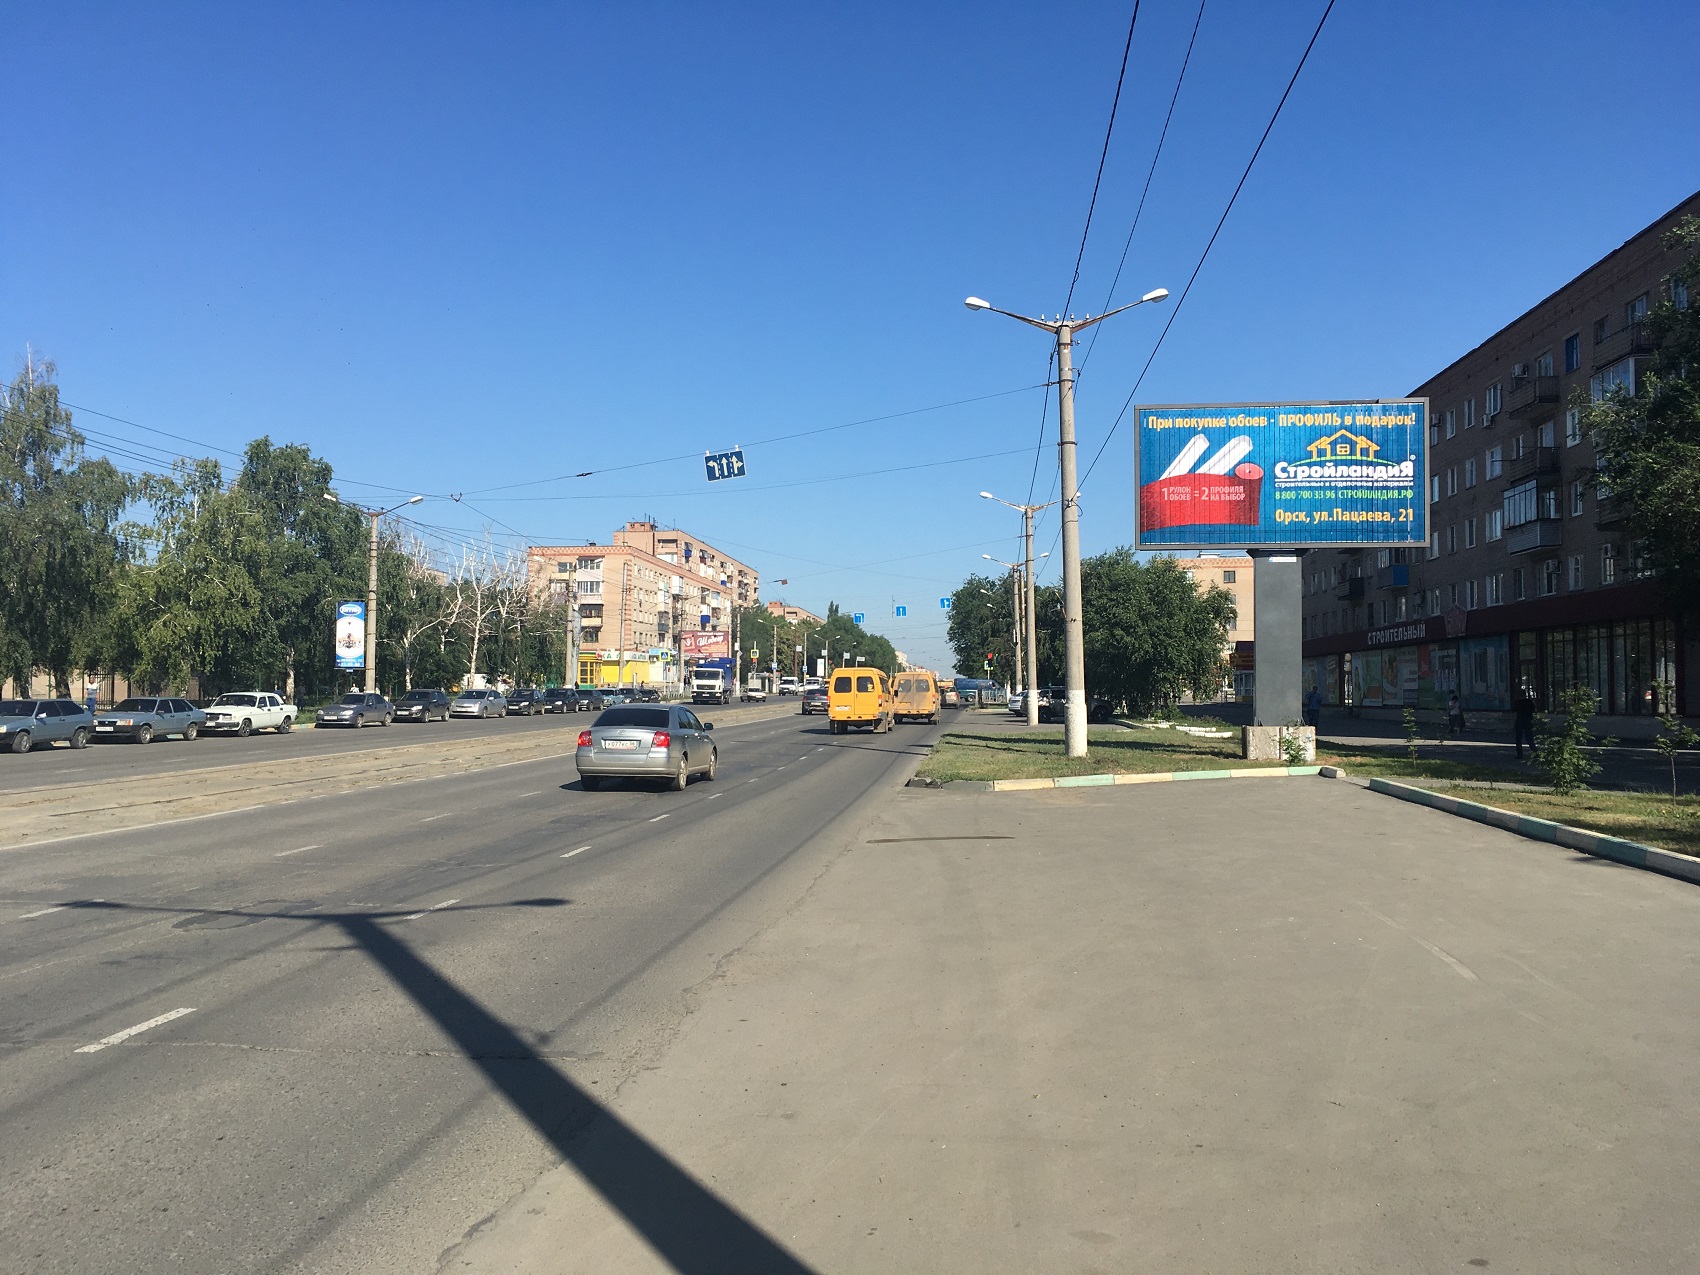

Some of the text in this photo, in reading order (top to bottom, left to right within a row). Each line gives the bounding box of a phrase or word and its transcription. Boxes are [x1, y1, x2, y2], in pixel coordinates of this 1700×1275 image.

[1148, 415, 1173, 431] При
[1175, 416, 1227, 431] покупке
[1229, 414, 1268, 427] обоев
[1278, 413, 1342, 427] ПРОФИЛЬ
[1344, 415, 1353, 426] в
[1355, 412, 1416, 428] подарок!
[1373, 480, 1414, 488] материалы
[1161, 486, 1192, 500] 1 РУЛОН
[1169, 493, 1192, 501] ОБОЕВ
[1201, 485, 1244, 500] 2 ПРОФИЛЯ
[1210, 493, 1246, 501] НА ВЫБОР
[1275, 488, 1414, 500] 8 800 700 33 96 СТРОЙЛАНДИЯ.РФ
[1275, 508, 1311, 525] Орск,
[1398, 508, 1414, 521] 21
[1367, 621, 1426, 645] СТРОИТЕЛЬНЫЙ
